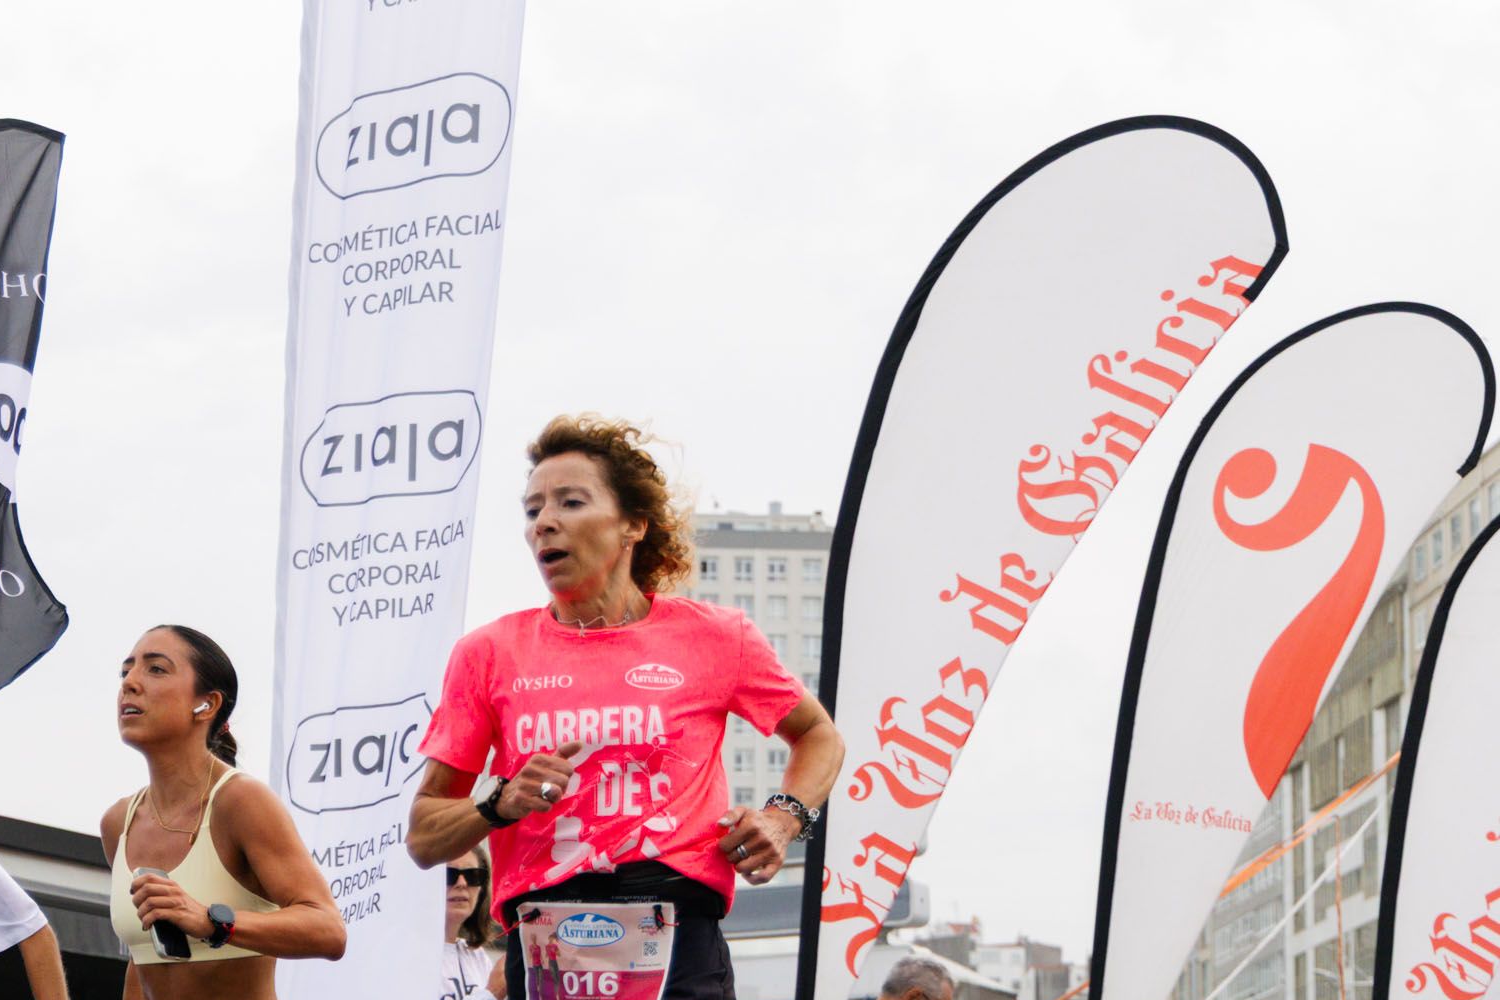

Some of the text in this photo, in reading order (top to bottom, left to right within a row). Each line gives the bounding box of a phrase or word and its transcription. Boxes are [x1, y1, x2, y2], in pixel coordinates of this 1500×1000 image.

[425, 209, 501, 238] FACIAL
[342, 248, 461, 286] CORPORAL
[343, 281, 454, 317] Y CAPILAR
[320, 418, 464, 482] ziaja
[328, 560, 441, 595] CORPORAL
[332, 592, 434, 628] Y CAPILAR
[512, 675, 573, 693] OYSHO
[561, 926, 619, 939] ASTURIANA
[562, 971, 619, 996] 016
